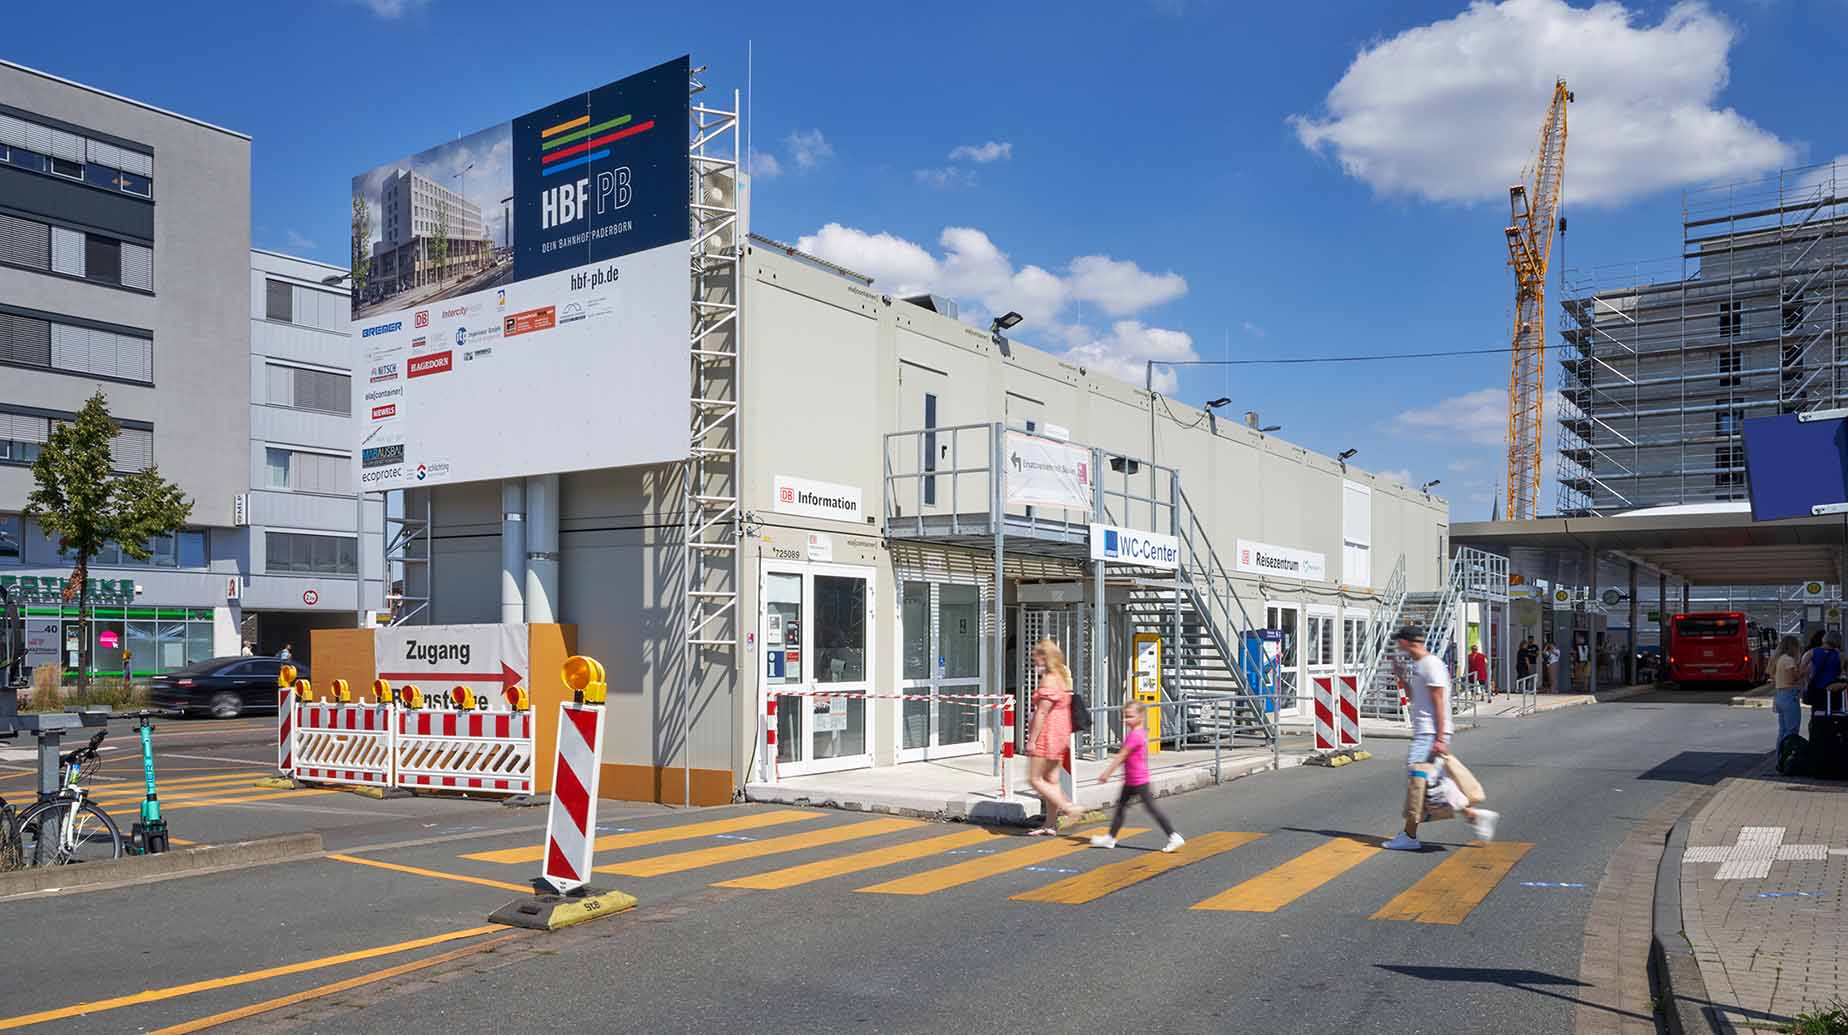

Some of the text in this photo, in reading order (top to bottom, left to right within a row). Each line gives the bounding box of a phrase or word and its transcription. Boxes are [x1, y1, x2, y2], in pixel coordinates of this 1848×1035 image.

[542, 166, 632, 230] HBF PB
[542, 221, 633, 254] DEIN BAHNHOF PADERBORN
[570, 265, 619, 291] hbf-pb.de
[416, 312, 429, 326] DB
[362, 321, 402, 338] BREMER
[410, 357, 449, 373] HAGEDORN
[362, 467, 402, 482] ecoprotec
[780, 487, 857, 511] DB Information
[1256, 552, 1299, 571] Reisezentrum
[45, 625, 57, 633] 40
[406, 640, 471, 665] Zugang
